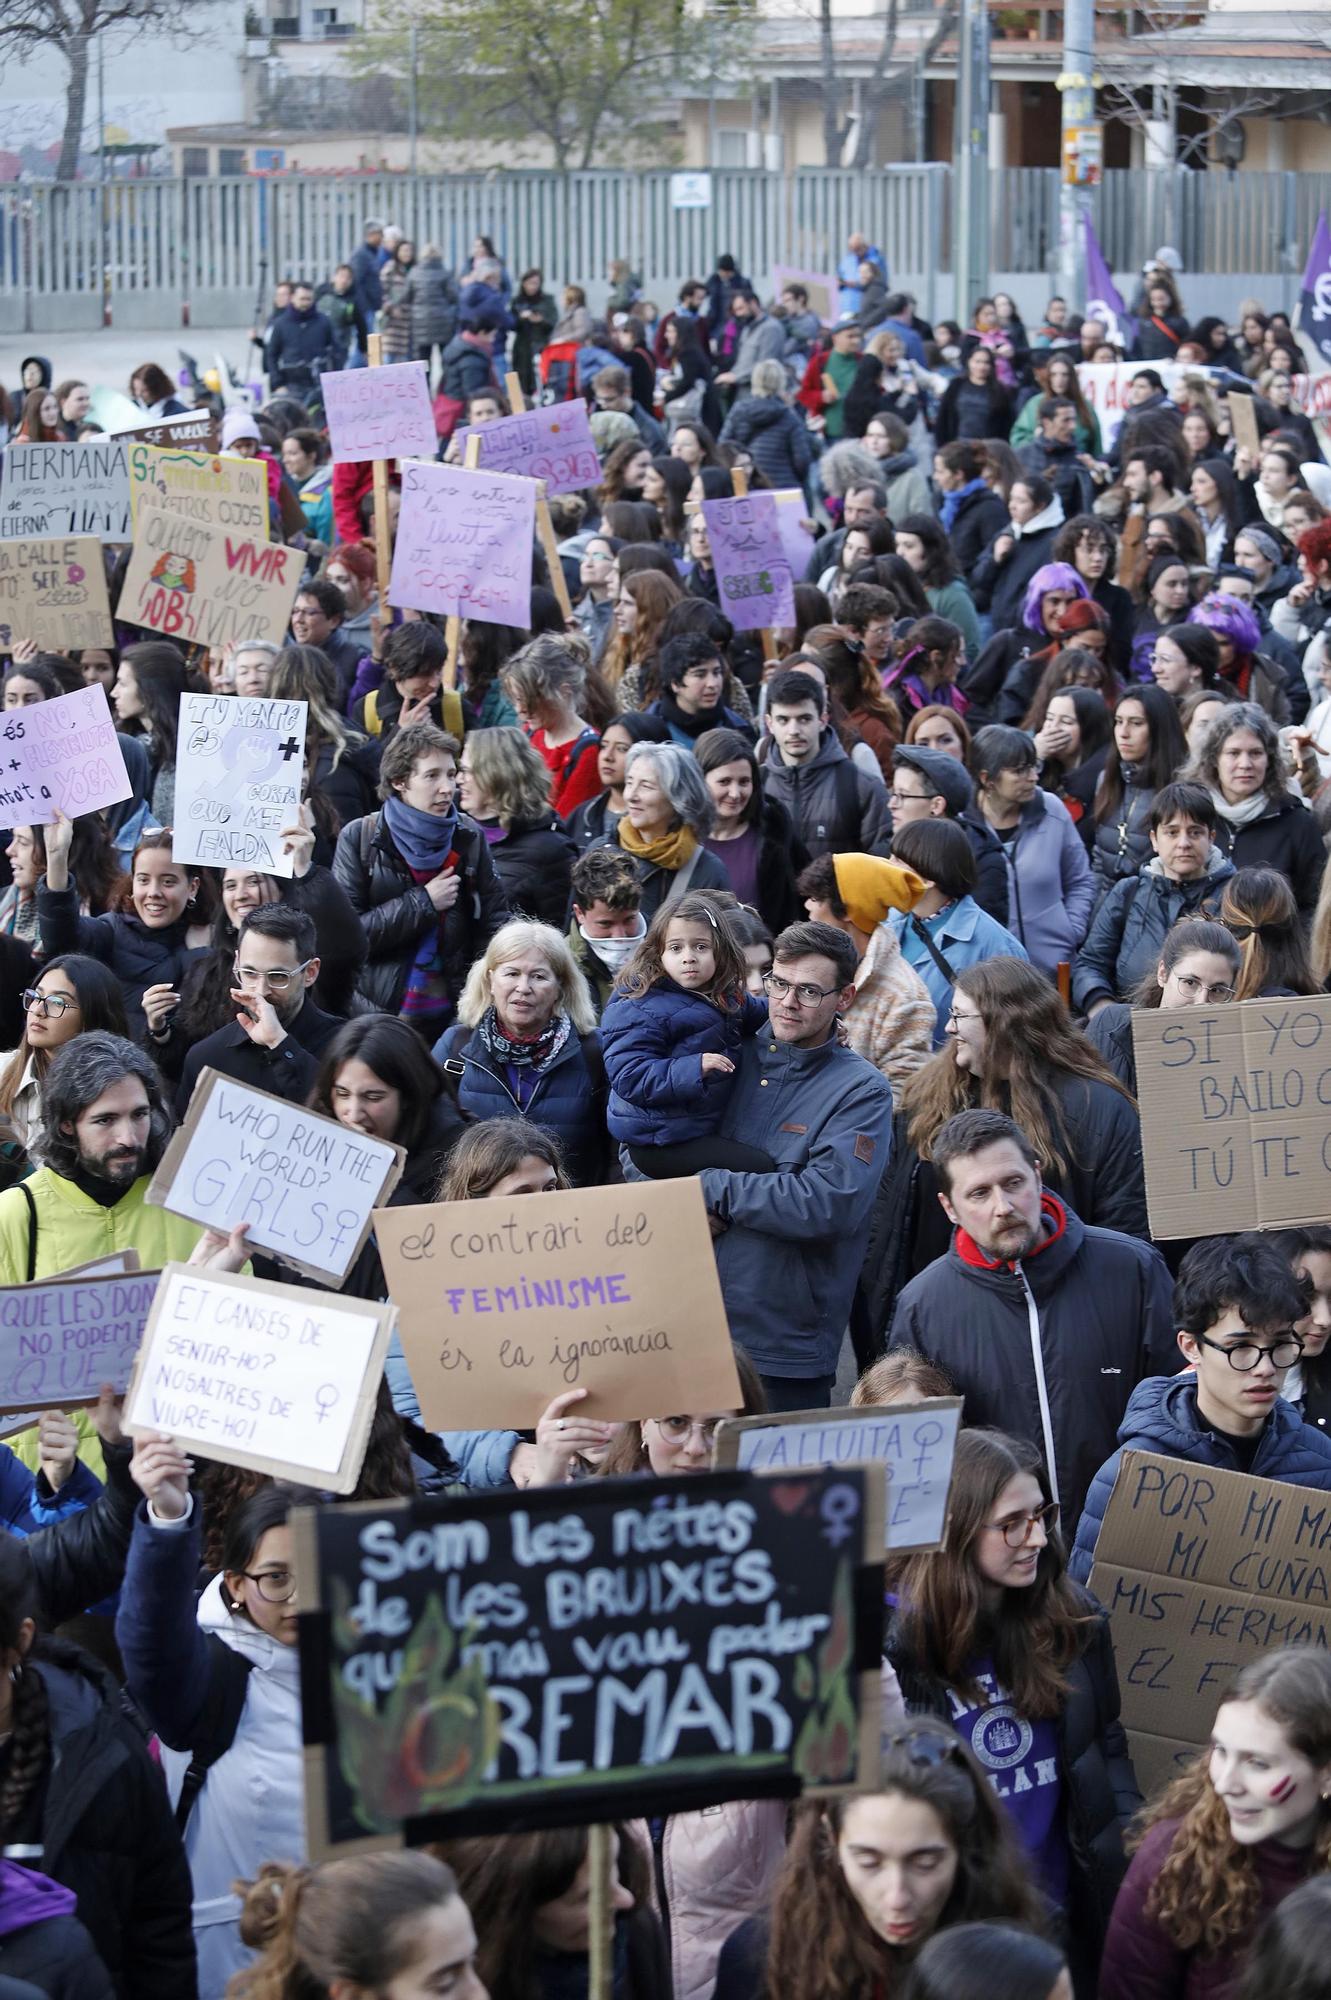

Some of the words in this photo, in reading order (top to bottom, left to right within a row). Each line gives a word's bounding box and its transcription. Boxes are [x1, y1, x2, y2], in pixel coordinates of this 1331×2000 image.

[10, 447, 128, 483] HERMANA
[2, 514, 49, 537] ETERNA
[225, 536, 288, 586] VIVIR
[3, 719, 25, 740] és
[54, 758, 119, 810] YOGA
[195, 829, 276, 868] FALDA
[1161, 1020, 1221, 1068] SI
[1262, 1011, 1323, 1056] YO
[1200, 1069, 1304, 1120] BAILO
[217, 1090, 280, 1141] WHO
[287, 1123, 336, 1167] RUN
[339, 1142, 382, 1184] THE
[240, 1139, 332, 1193] WORLD?
[1179, 1136, 1234, 1190] TÚ
[1253, 1136, 1301, 1178] TE
[192, 1158, 329, 1247] GIRLS
[450, 1212, 583, 1260] contrari
[605, 1211, 655, 1248] del
[19, 1332, 53, 1357] NO
[62, 1320, 131, 1351] PODEM
[172, 1284, 212, 1323] ET
[214, 1297, 291, 1341] CANSES
[299, 1317, 326, 1348] DE
[439, 1339, 473, 1372] és
[499, 1338, 535, 1368] la
[549, 1324, 674, 1384] ignorància
[154, 1363, 262, 1412] NOSALTRES
[268, 1395, 294, 1419] DE
[1133, 1464, 1215, 1526] POR
[1240, 1489, 1282, 1544] MI
[1167, 1530, 1208, 1578] MI
[348, 1577, 412, 1637] de
[544, 1549, 777, 1631] BRUIXES
[1111, 1575, 1184, 1620] MIS
[341, 1648, 406, 1703] qu
[459, 1626, 550, 1680] mai
[706, 1600, 832, 1675] poder
[1127, 1646, 1174, 1690] EL
[986, 1756, 1059, 1798] LAN
